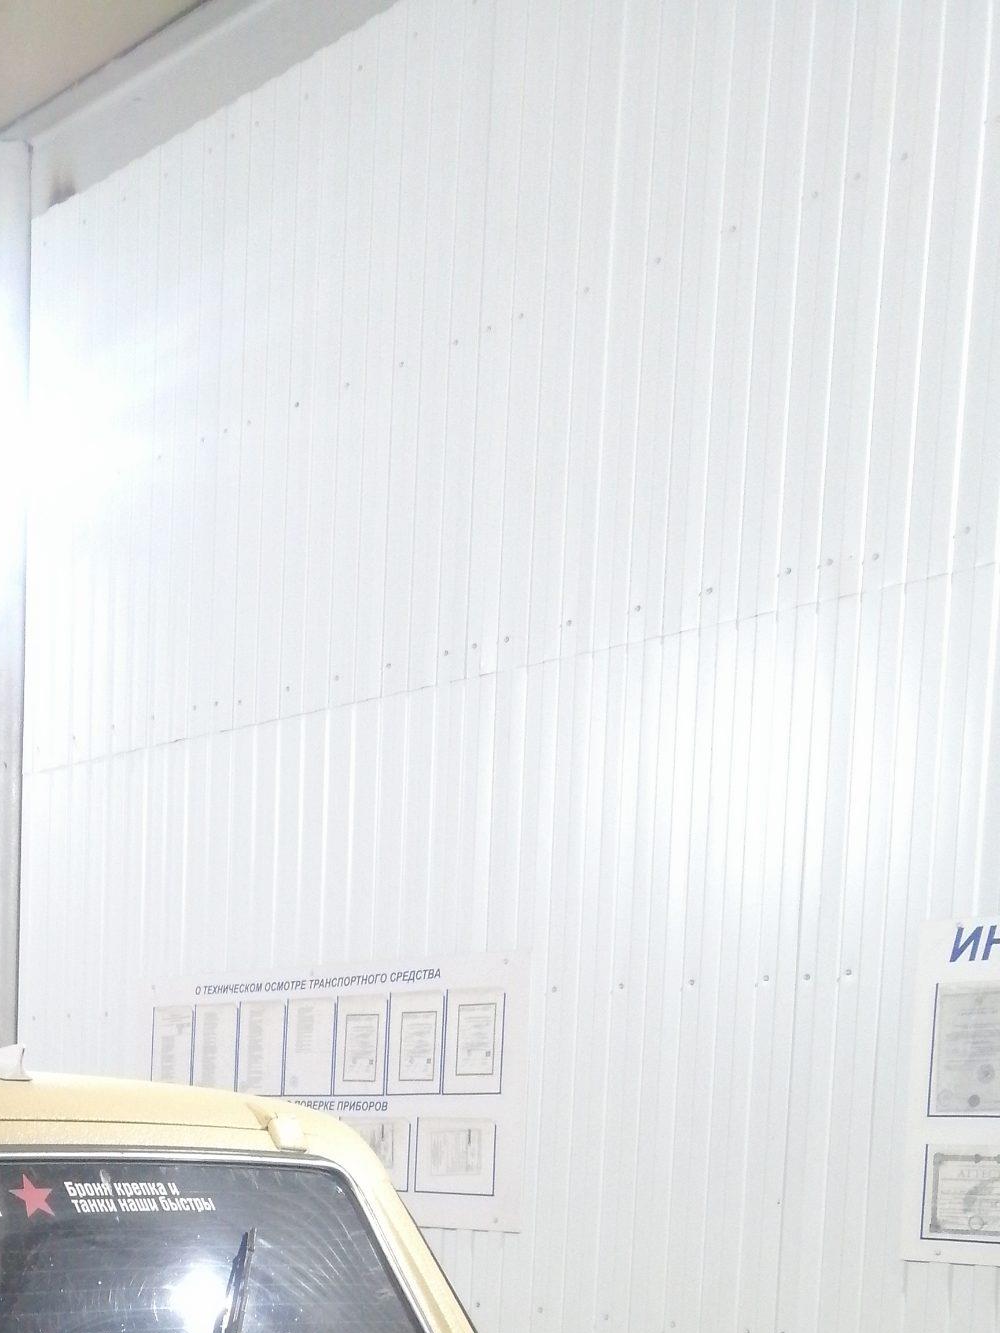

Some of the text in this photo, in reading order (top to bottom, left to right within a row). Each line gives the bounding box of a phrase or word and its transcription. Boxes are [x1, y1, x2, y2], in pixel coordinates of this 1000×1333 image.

[195, 968, 441, 996] О ТЕХНИЧЕСКОМ ОСМОТРЕ ТРАНСПОРТНОГО СРЕДСТВА
[336, 1101, 389, 1112] ПРИБОРОВ
[63, 1181, 180, 1198] Броня крепка и
[71, 1196, 217, 1213] танки наши быстры
